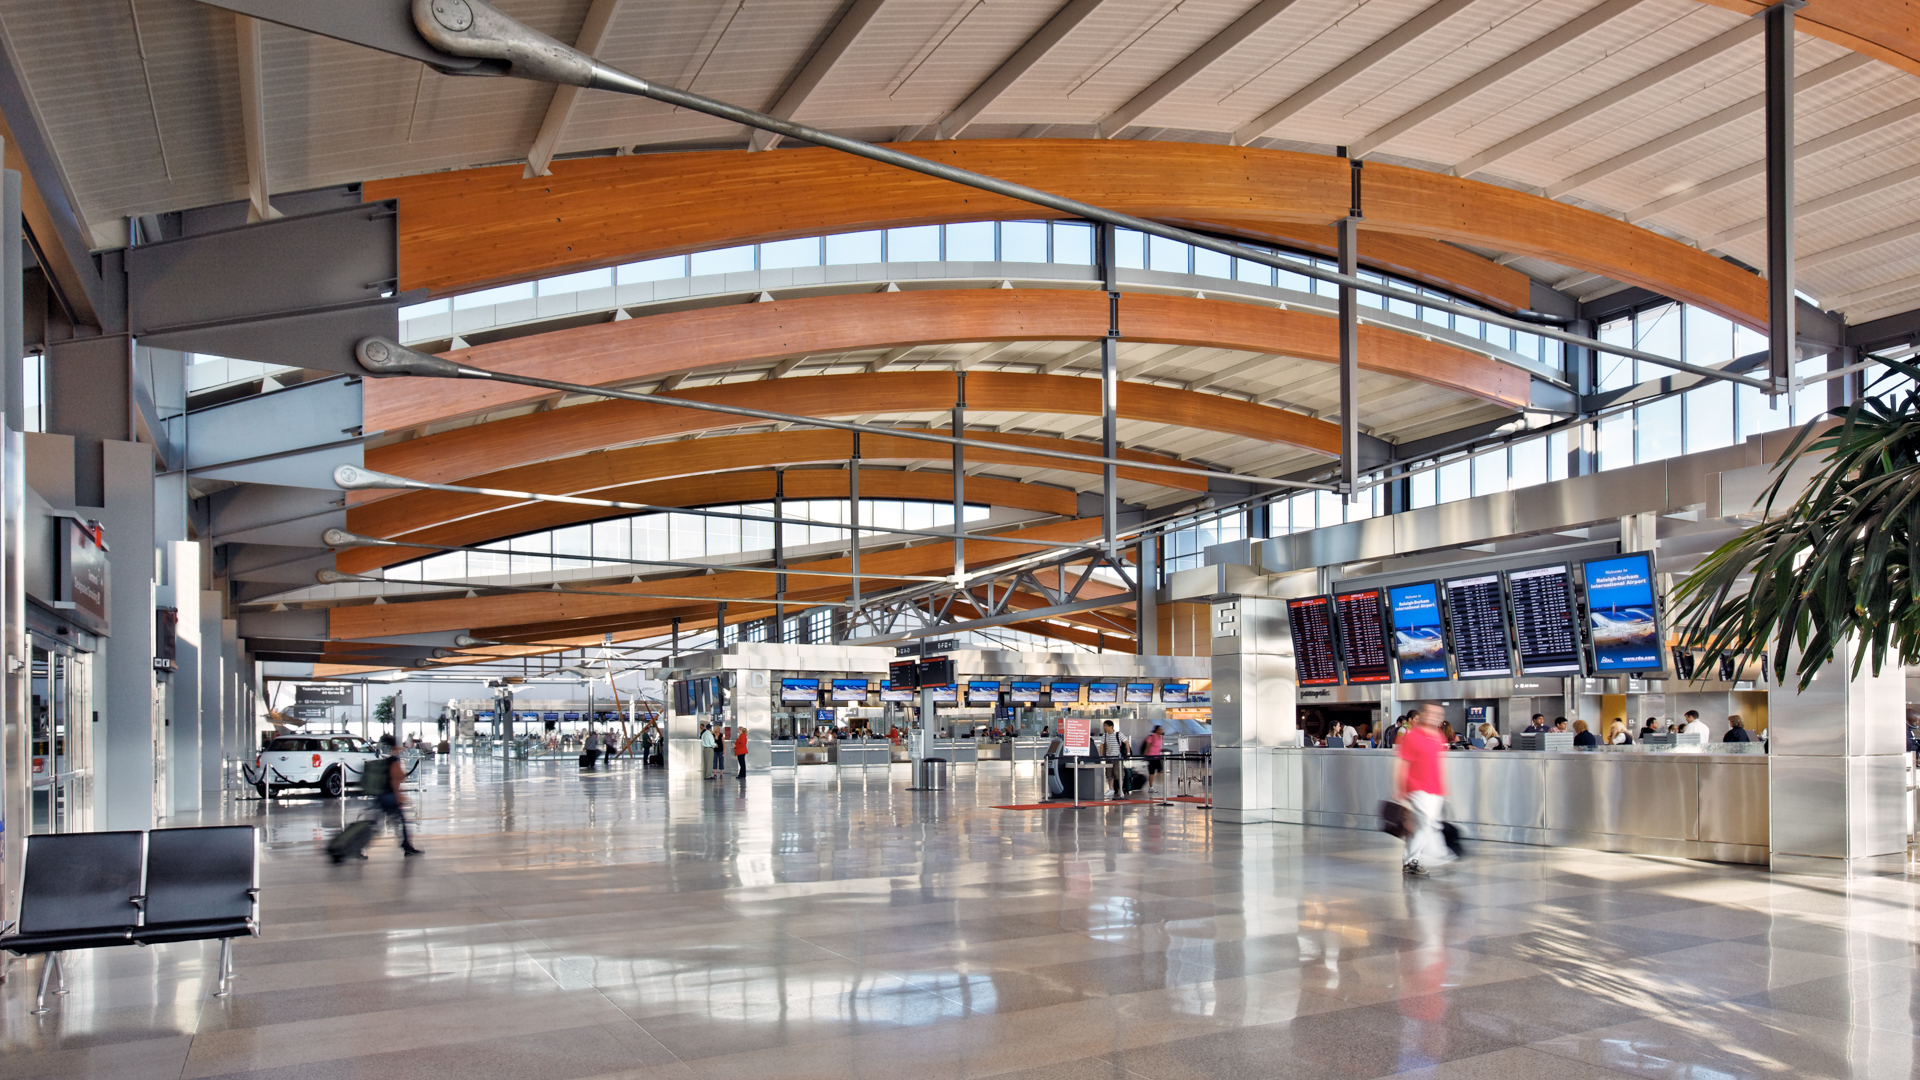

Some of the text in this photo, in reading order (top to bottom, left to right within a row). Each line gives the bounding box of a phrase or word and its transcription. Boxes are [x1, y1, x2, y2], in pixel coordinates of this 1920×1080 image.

[1591, 578, 1646, 589] International Airport
[1596, 574, 1639, 583] Raleigh-Durham
[1399, 599, 1430, 607] Raleigh-Durham
[1213, 602, 1235, 637] E
[751, 671, 765, 688] D
[466, 709, 473, 717] B
